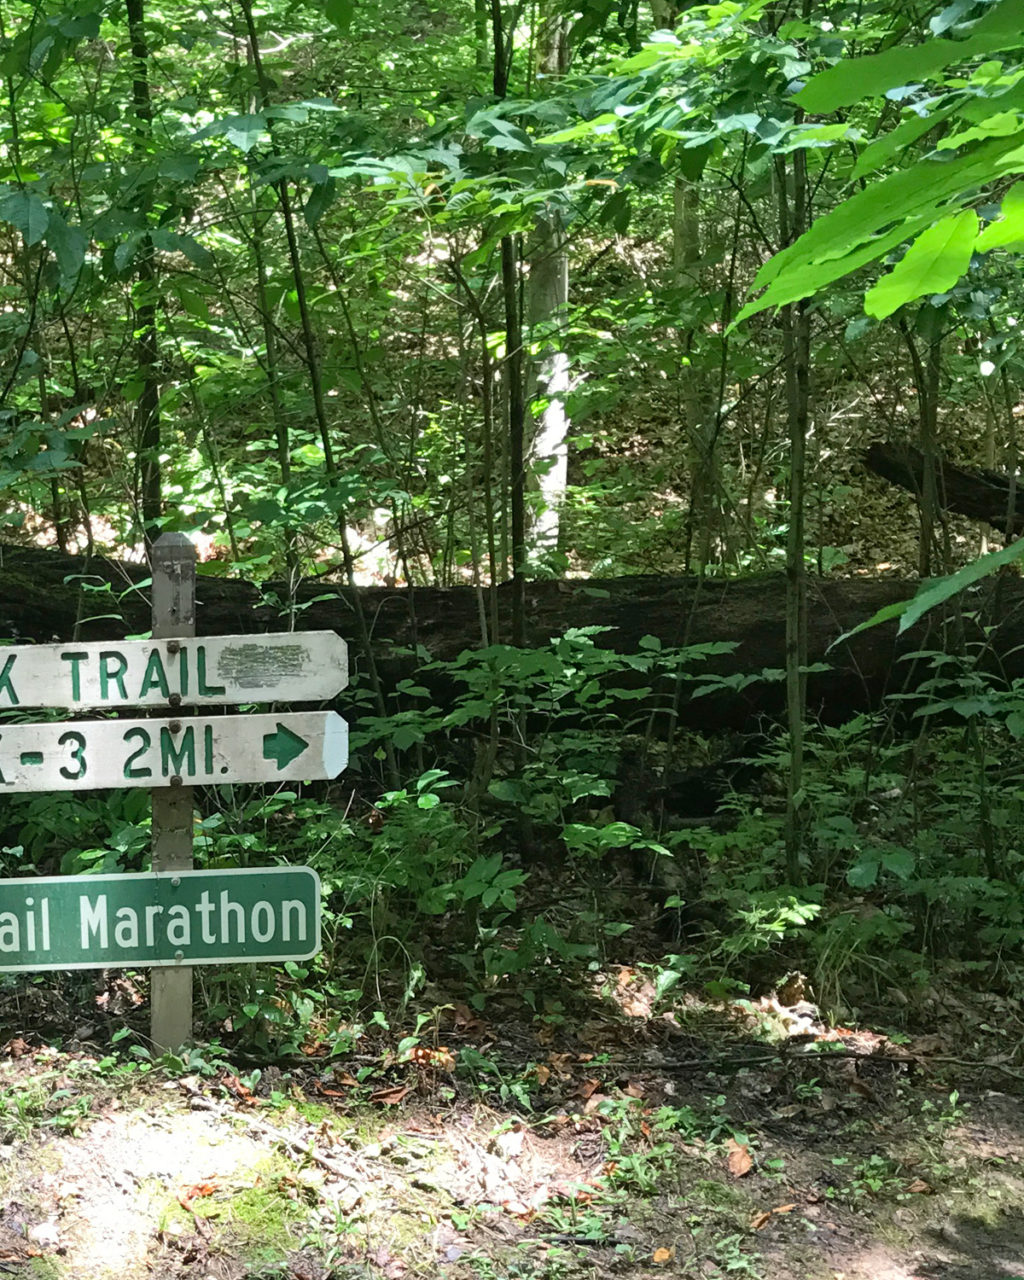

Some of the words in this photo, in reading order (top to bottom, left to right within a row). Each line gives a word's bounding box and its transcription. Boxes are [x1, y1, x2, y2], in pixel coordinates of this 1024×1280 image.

[61, 645, 226, 701] TRAIL
[123, 725, 229, 778] 2MI.
[80, 890, 308, 950] Marathon
